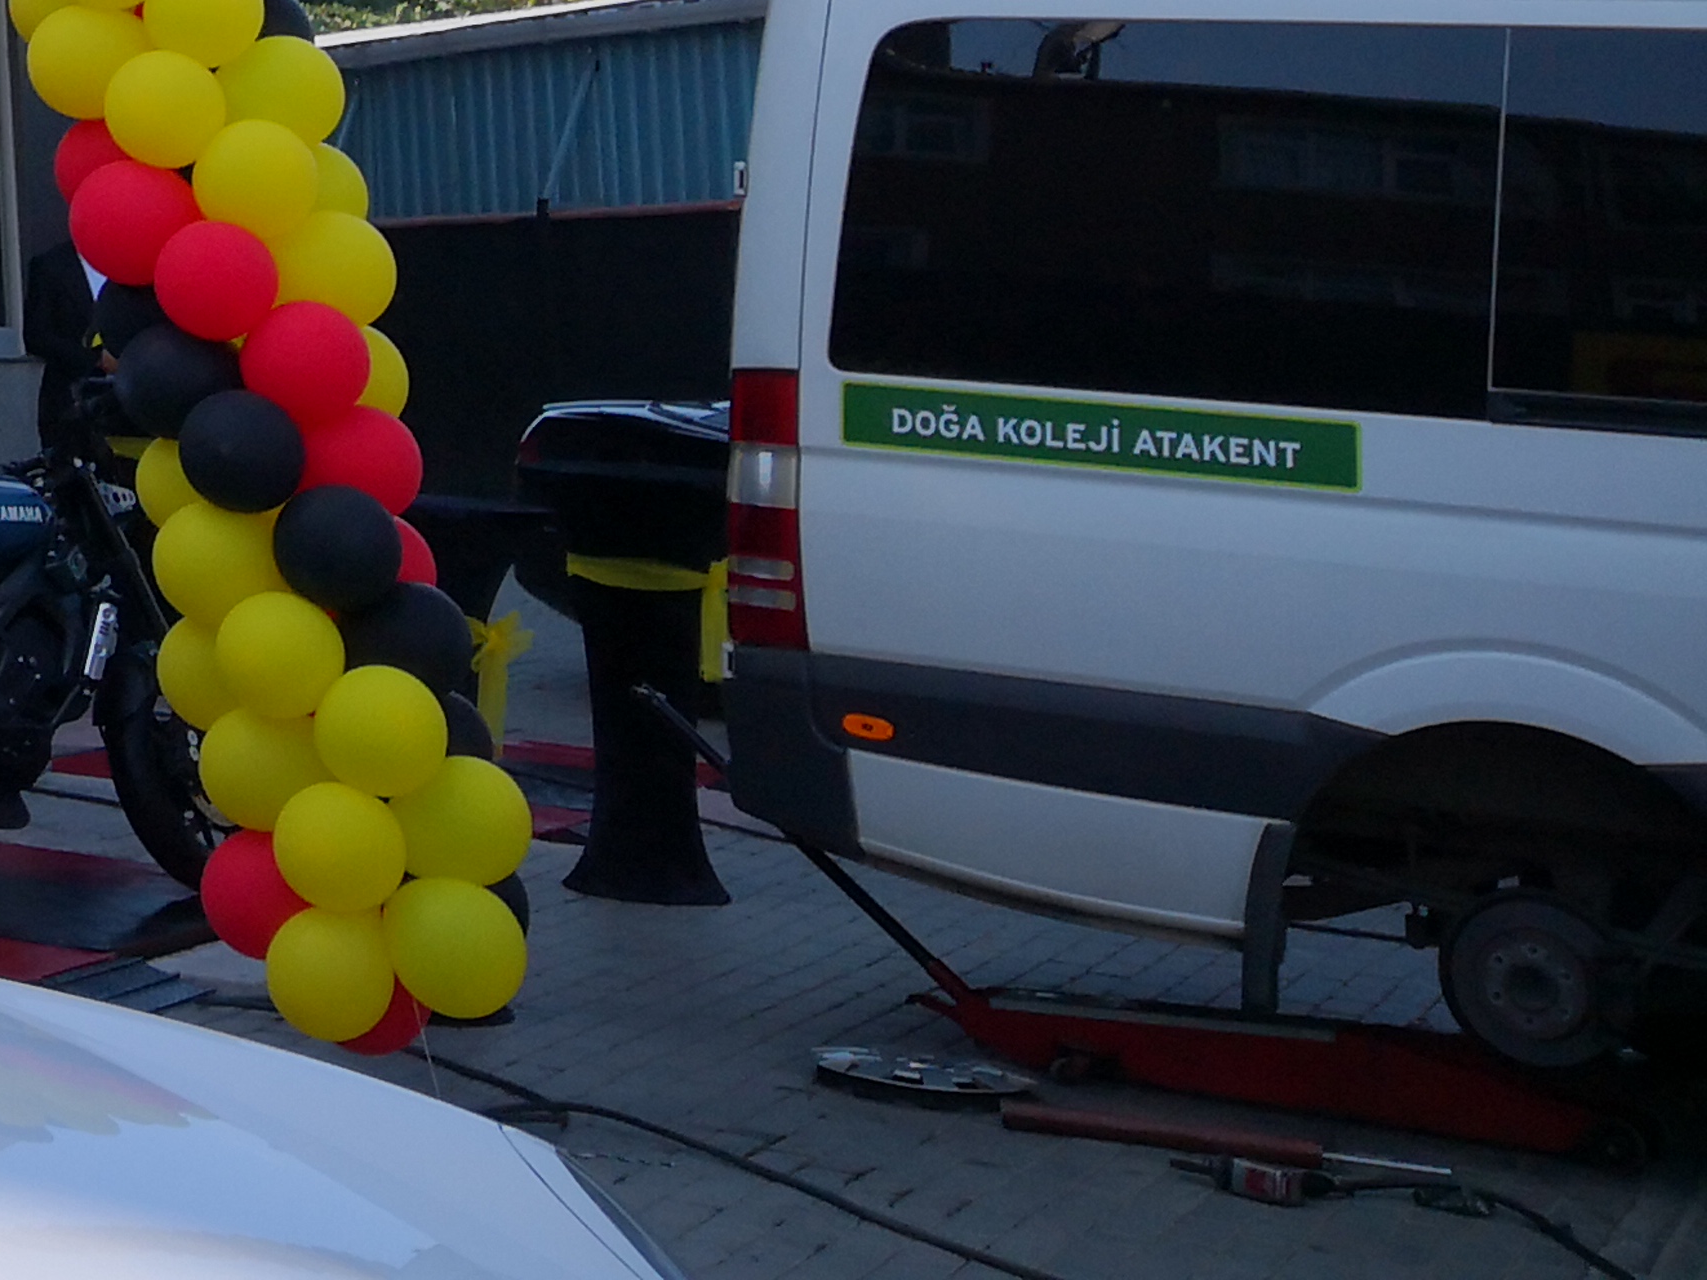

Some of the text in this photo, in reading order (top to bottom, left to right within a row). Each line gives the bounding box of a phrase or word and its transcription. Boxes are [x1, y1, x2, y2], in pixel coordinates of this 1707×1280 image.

[892, 404, 1301, 469] DOĞA KOLEJİ ATAKENT
